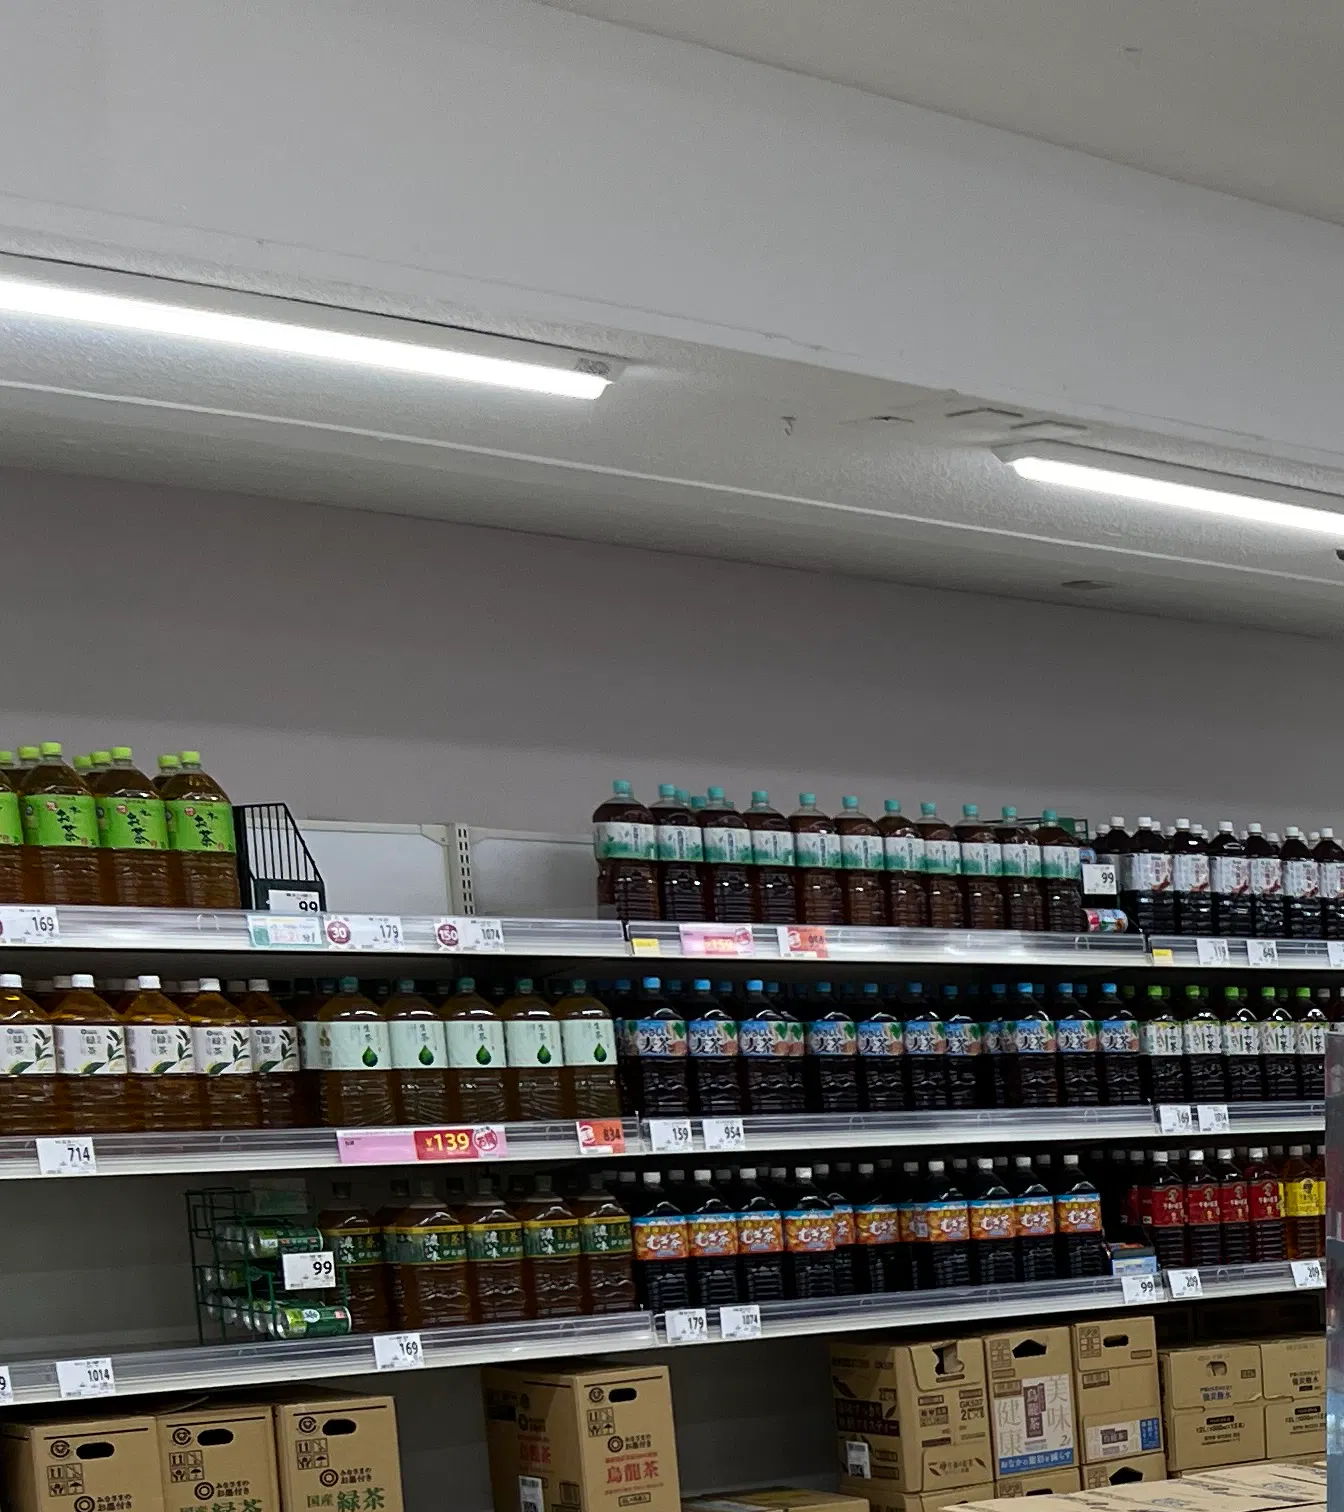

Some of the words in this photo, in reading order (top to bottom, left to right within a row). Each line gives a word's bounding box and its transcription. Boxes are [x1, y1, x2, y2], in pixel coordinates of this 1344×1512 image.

[1101, 872, 1114, 884] 99
[32, 916, 55, 932] 169
[379, 924, 399, 939] 179
[672, 1126, 689, 1141] 159
[724, 1125, 741, 1139] 954
[425, 1132, 469, 1152] ¥139
[67, 1146, 91, 1162] 714
[312, 1260, 333, 1275] 99
[1140, 1281, 1154, 1293] 99
[687, 1317, 704, 1331] 179
[399, 1340, 419, 1356] 169
[87, 1367, 110, 1383] 1014
